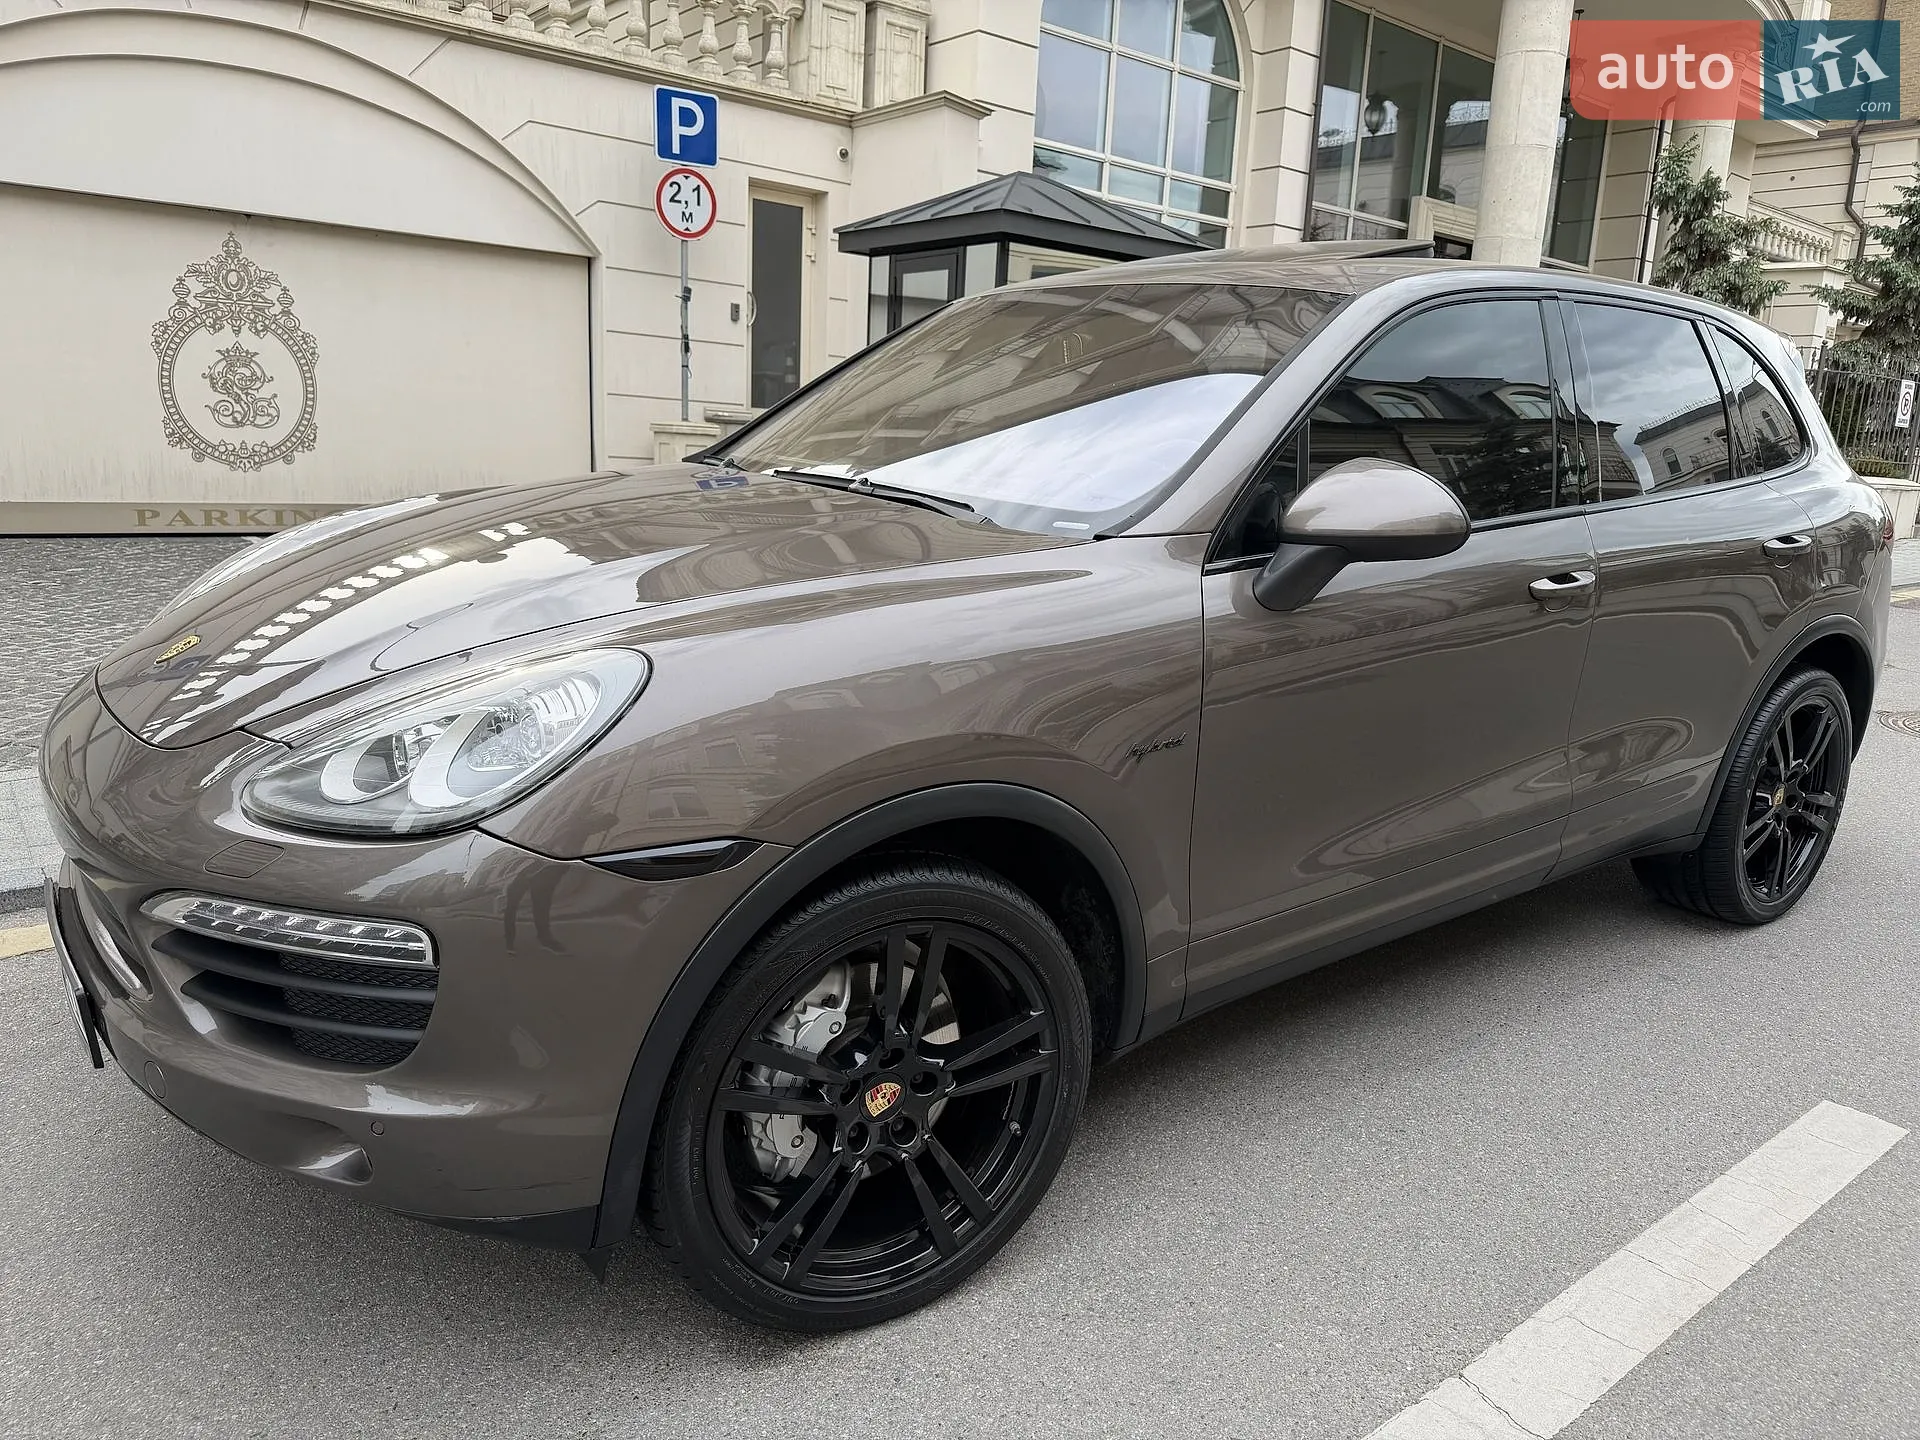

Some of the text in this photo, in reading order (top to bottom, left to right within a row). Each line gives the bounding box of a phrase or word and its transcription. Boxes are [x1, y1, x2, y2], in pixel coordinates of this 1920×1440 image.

[671, 96, 705, 155] P
[668, 180, 701, 209] 2,1
[133, 508, 344, 528] PARKIN
